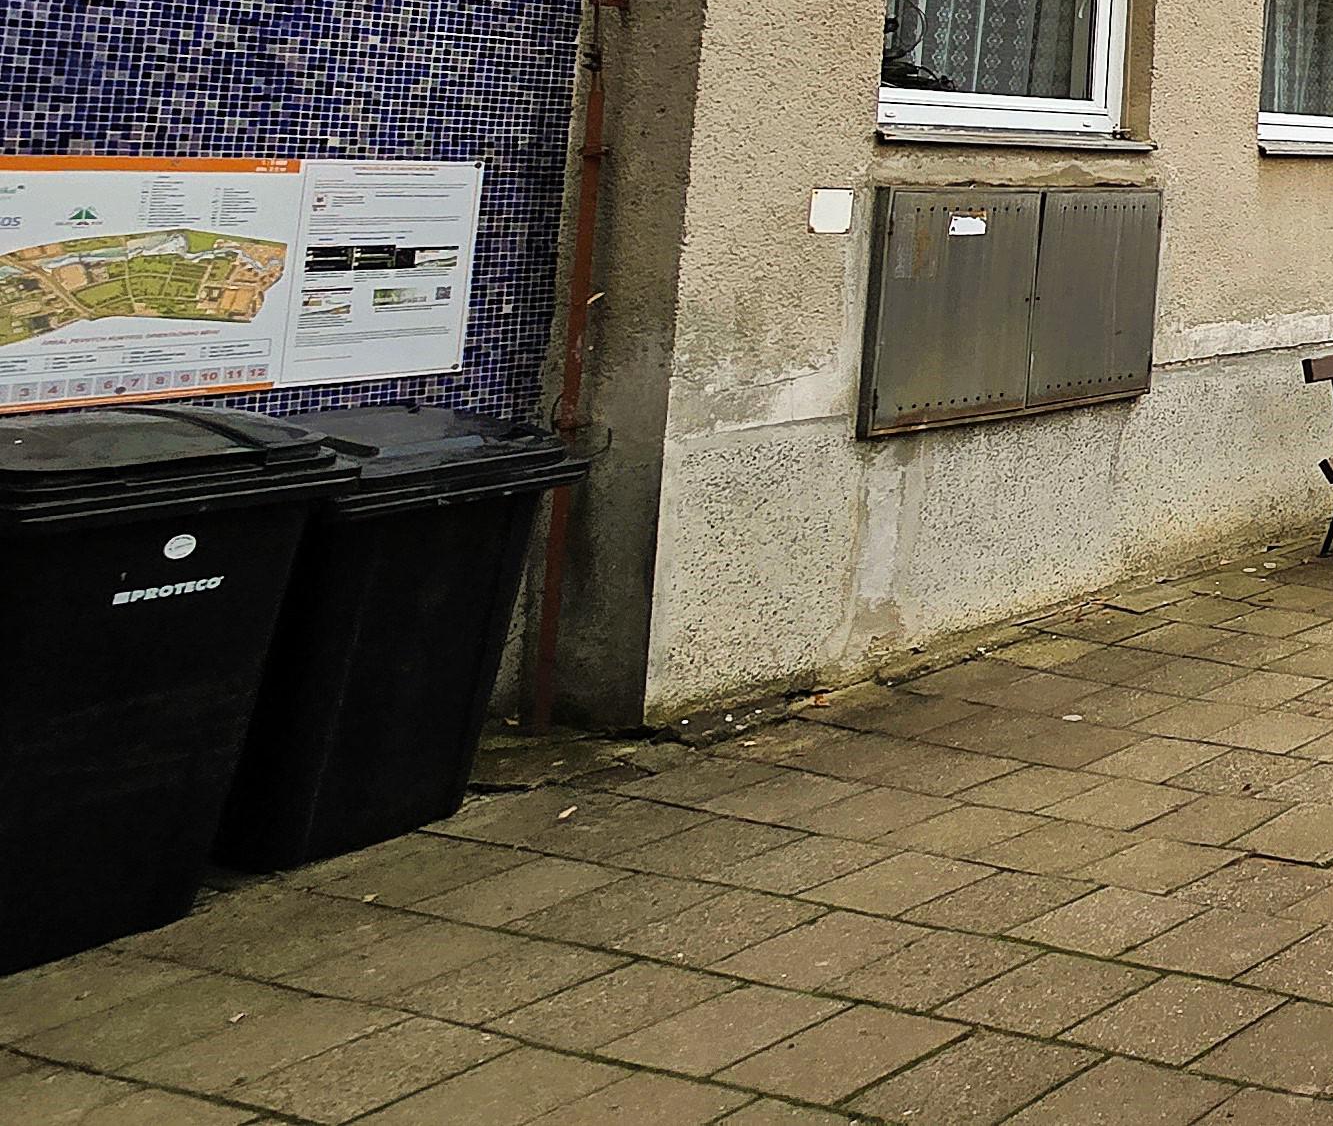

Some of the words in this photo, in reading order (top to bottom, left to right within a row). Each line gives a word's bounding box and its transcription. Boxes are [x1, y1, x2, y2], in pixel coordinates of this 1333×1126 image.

[131, 378, 140, 387] 7
[202, 372, 218, 381] 10
[227, 370, 242, 378] 11
[249, 368, 266, 376] 12
[130, 576, 224, 603] PROTECO
